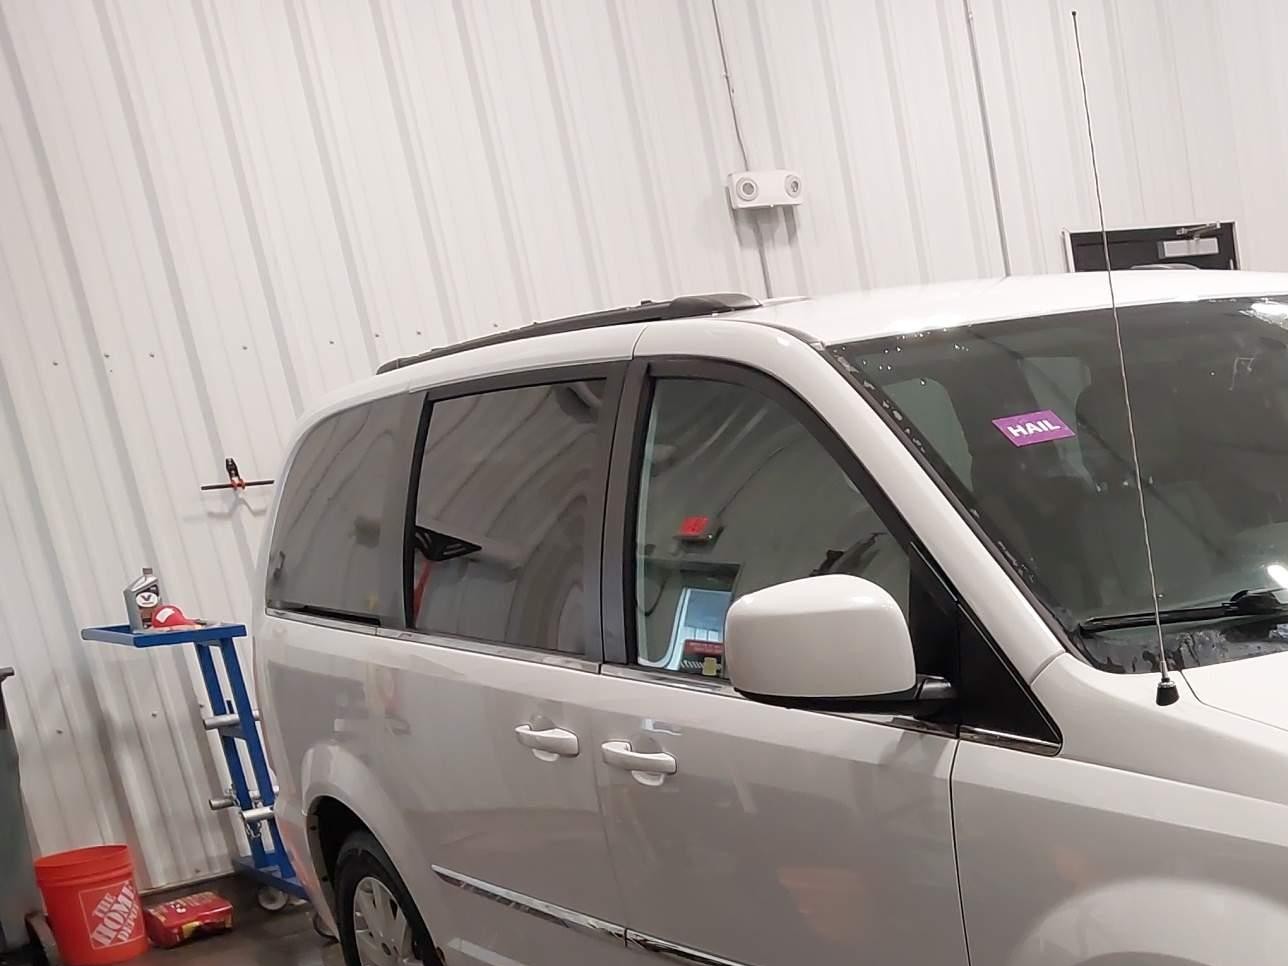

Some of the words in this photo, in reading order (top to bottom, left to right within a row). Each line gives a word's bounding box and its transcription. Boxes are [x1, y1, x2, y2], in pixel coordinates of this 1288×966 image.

[1007, 420, 1061, 437] HAIL
[91, 882, 135, 946] HOME
[92, 892, 117, 918] THE
